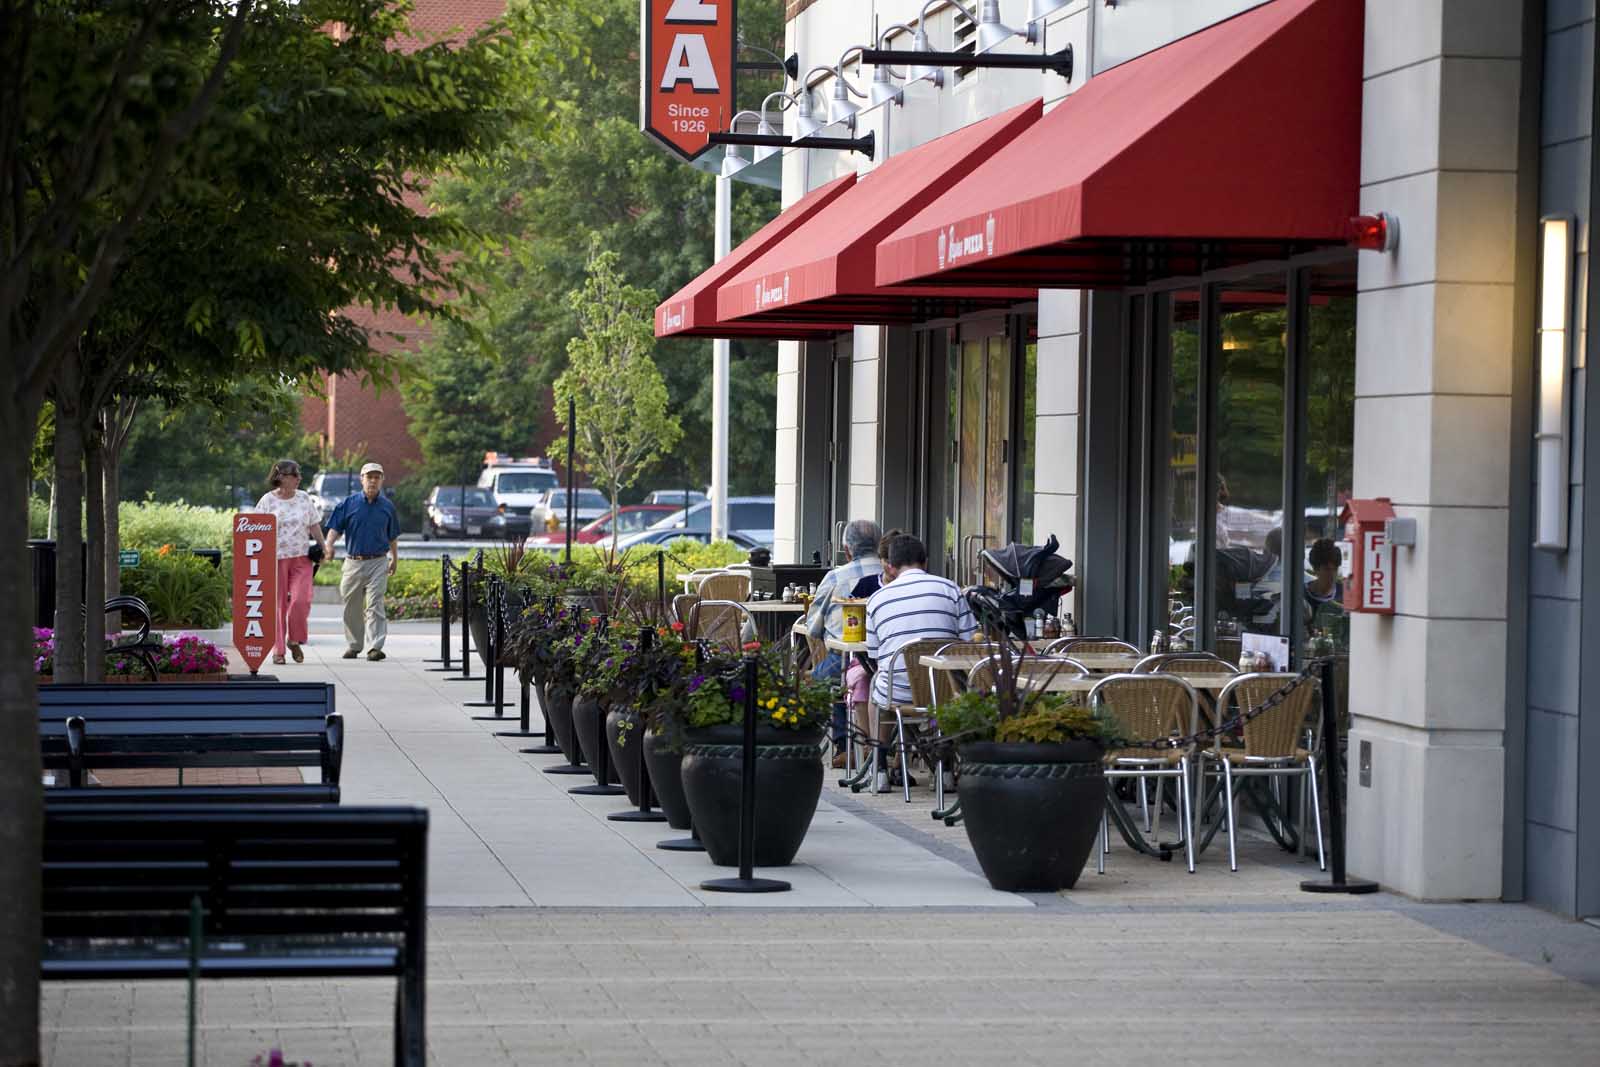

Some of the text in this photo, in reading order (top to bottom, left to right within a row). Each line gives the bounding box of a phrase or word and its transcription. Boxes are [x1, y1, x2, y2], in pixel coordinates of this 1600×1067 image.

[668, 103, 710, 118] Since
[671, 119, 706, 133] 1926
[235, 517, 273, 533] Regina
[1369, 535, 1385, 605] FIRE
[244, 539, 264, 639] PIZZA
